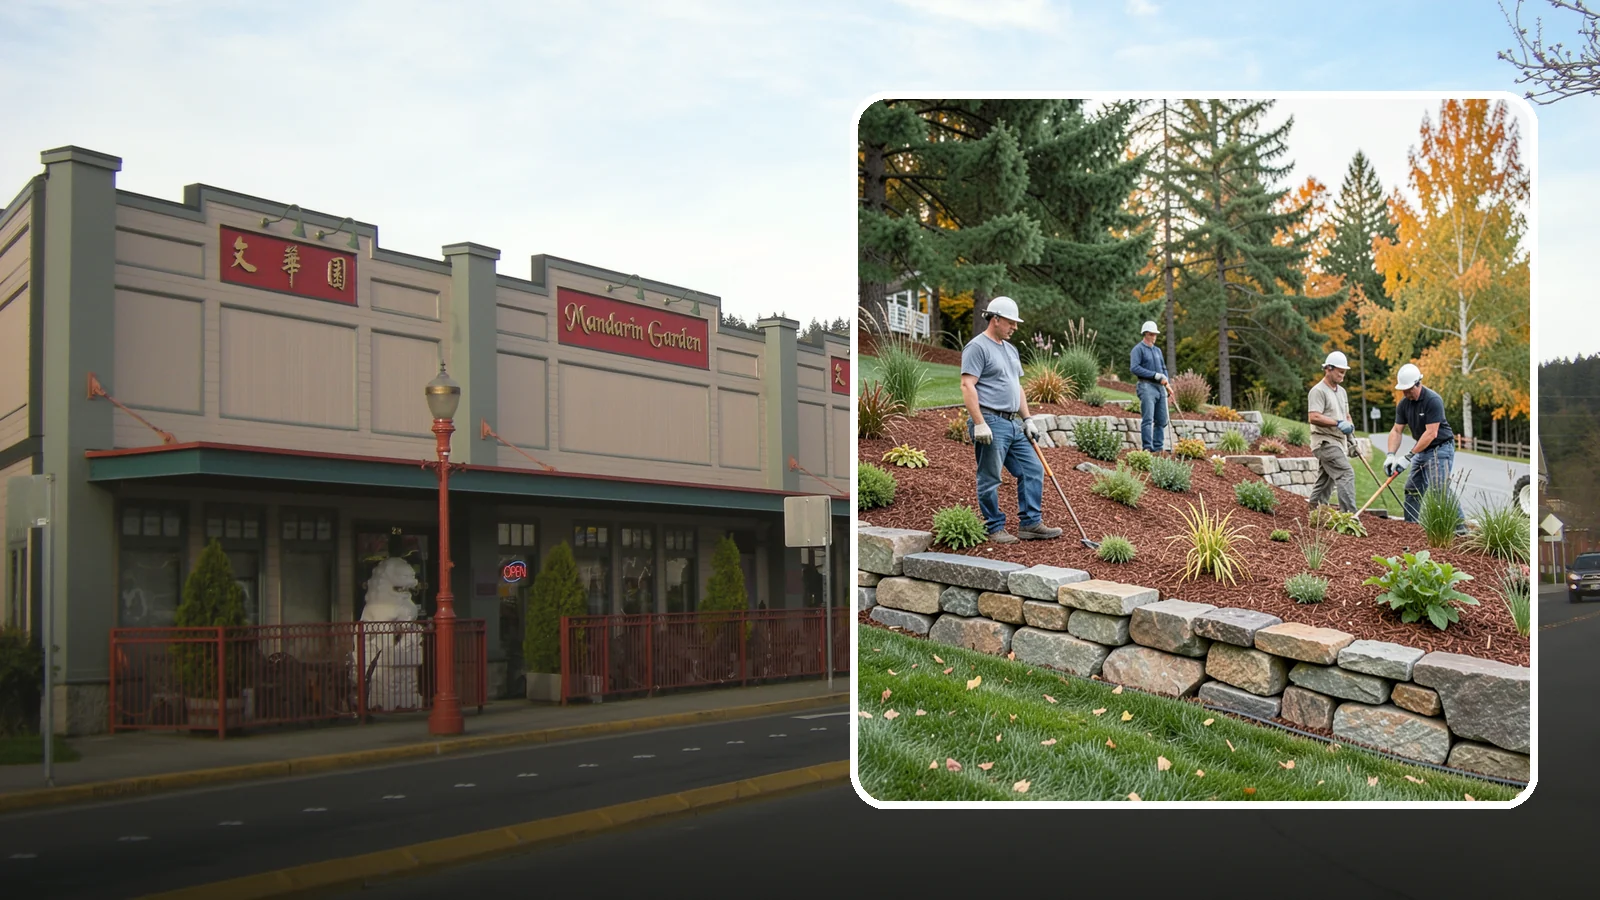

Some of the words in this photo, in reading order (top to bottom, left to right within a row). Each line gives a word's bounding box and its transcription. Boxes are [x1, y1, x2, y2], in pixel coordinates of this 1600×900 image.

[231, 236, 346, 291] 文華園
[564, 302, 644, 341] Mandarin
[647, 320, 702, 352] Garden
[503, 565, 527, 578] OPEN
